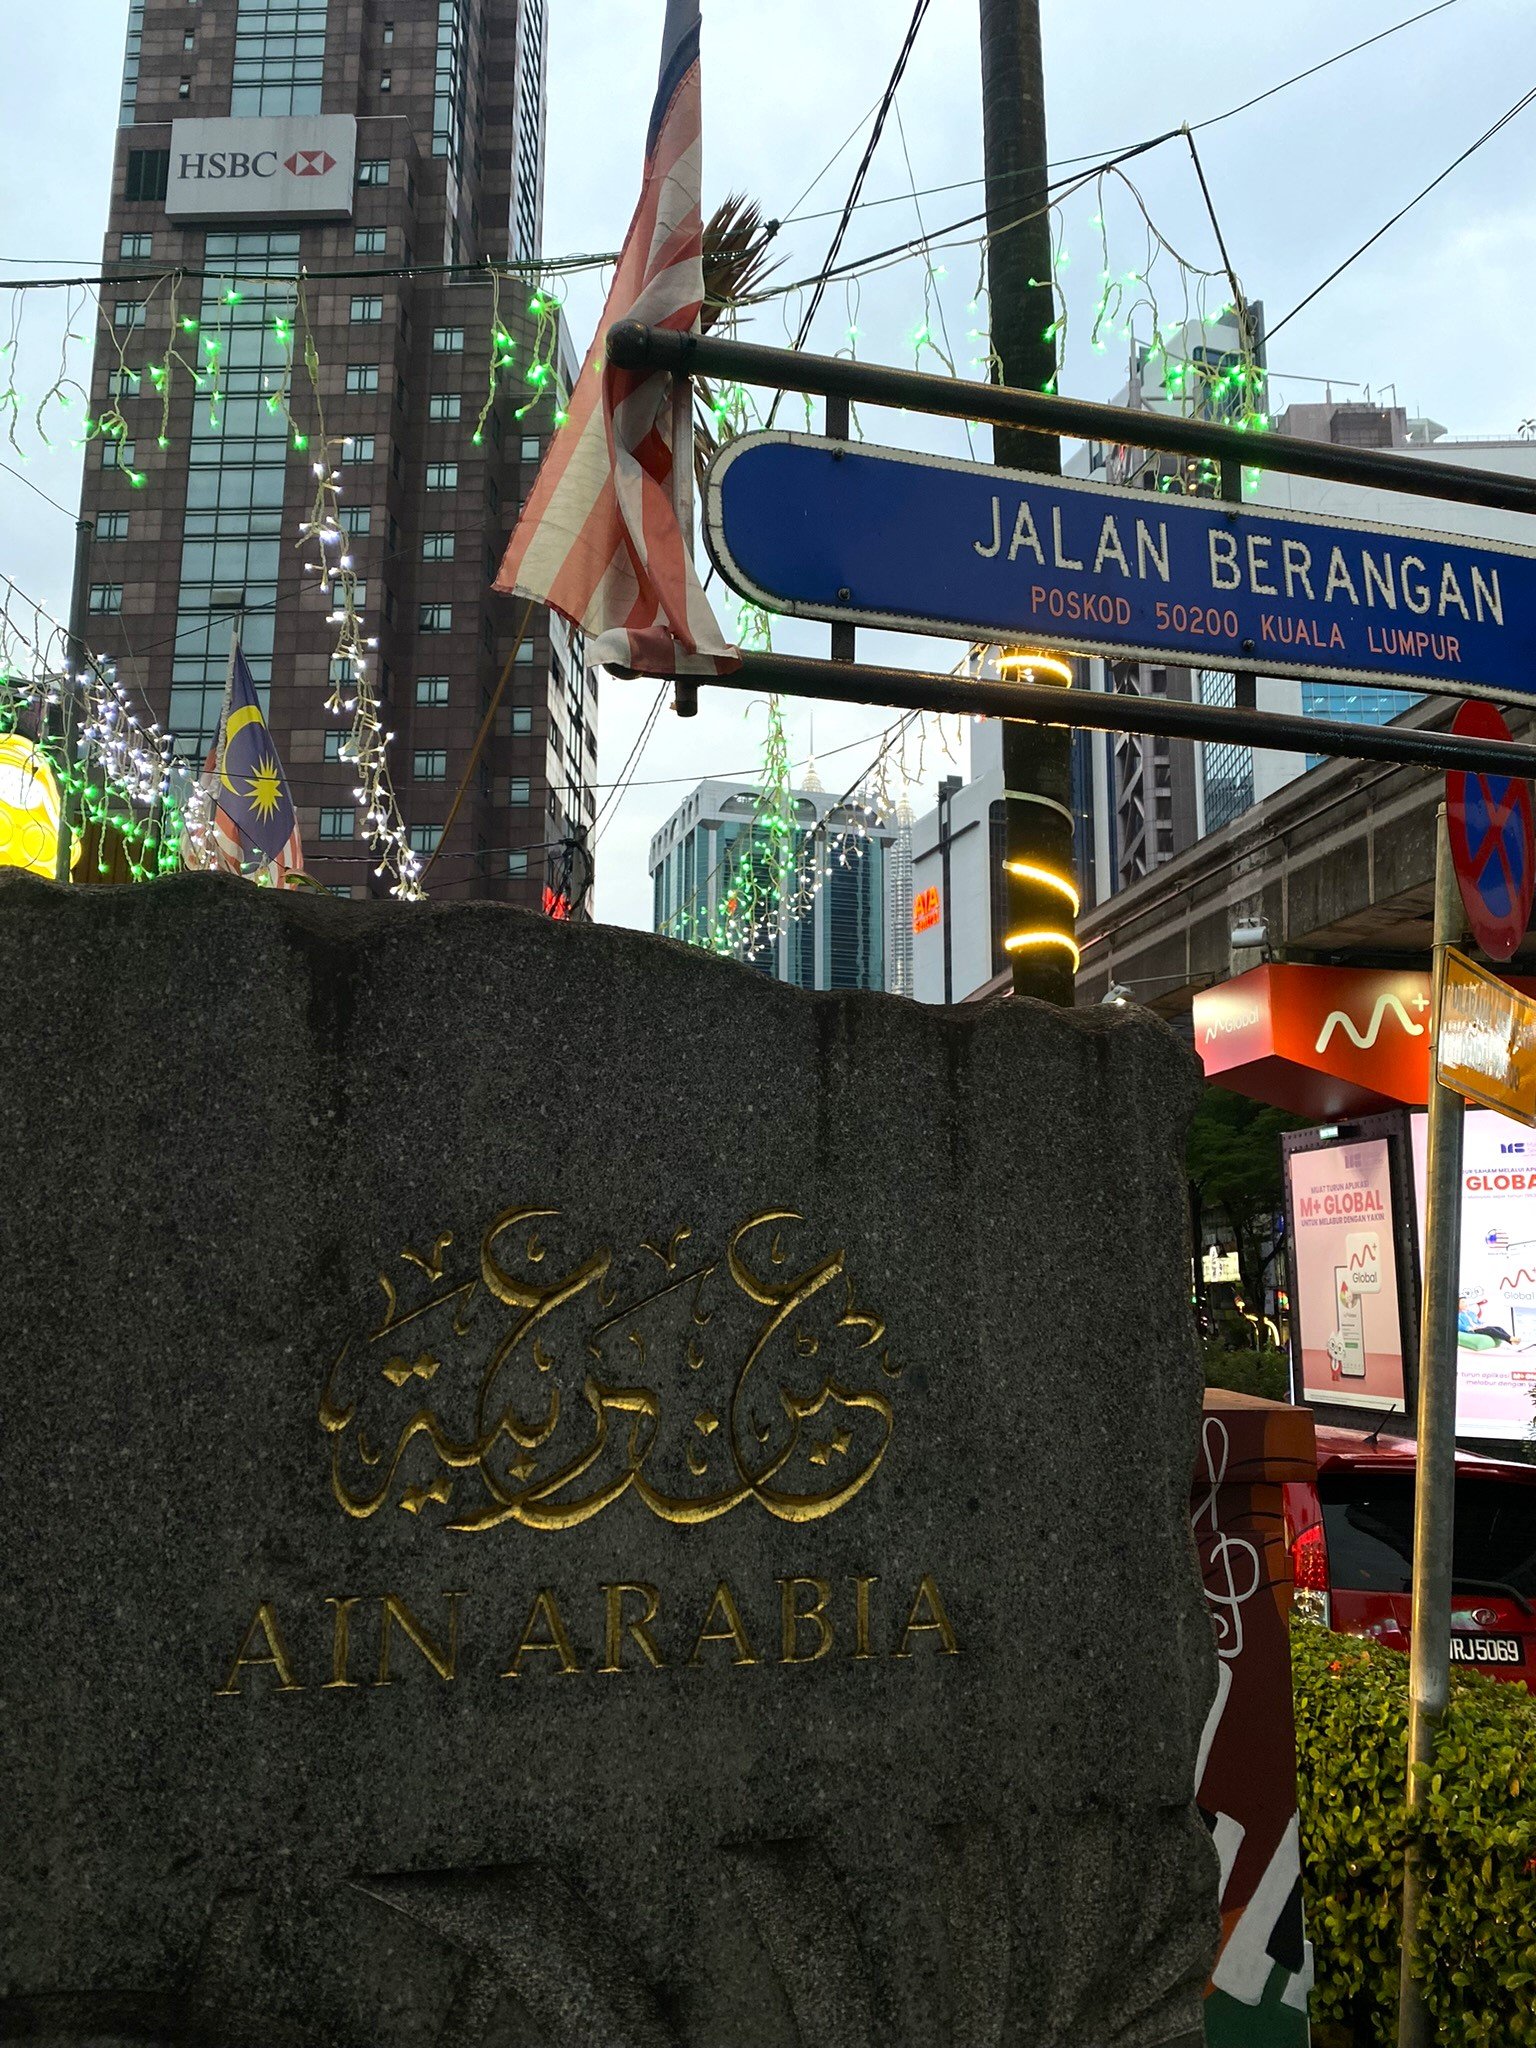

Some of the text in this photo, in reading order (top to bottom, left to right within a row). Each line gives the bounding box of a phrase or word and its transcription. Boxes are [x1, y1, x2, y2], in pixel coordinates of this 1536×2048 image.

[177, 151, 277, 179] HSBC
[973, 496, 1505, 627] JALAN BERANGAN
[1032, 586, 1462, 663] POSKOD 50200 KUALA LUMPUR
[1326, 1183, 1345, 1192] TURUN
[1345, 1180, 1370, 1190] APLIKASI
[1300, 1189, 1384, 1217] M+ GLOBAL
[1301, 1213, 1385, 1227] UNTUK MELABUR DENGAN YAKIN
[1352, 1271, 1378, 1283] Global
[1504, 1291, 1535, 1300] Global
[212, 1573, 965, 1696] AIN ARABIA
